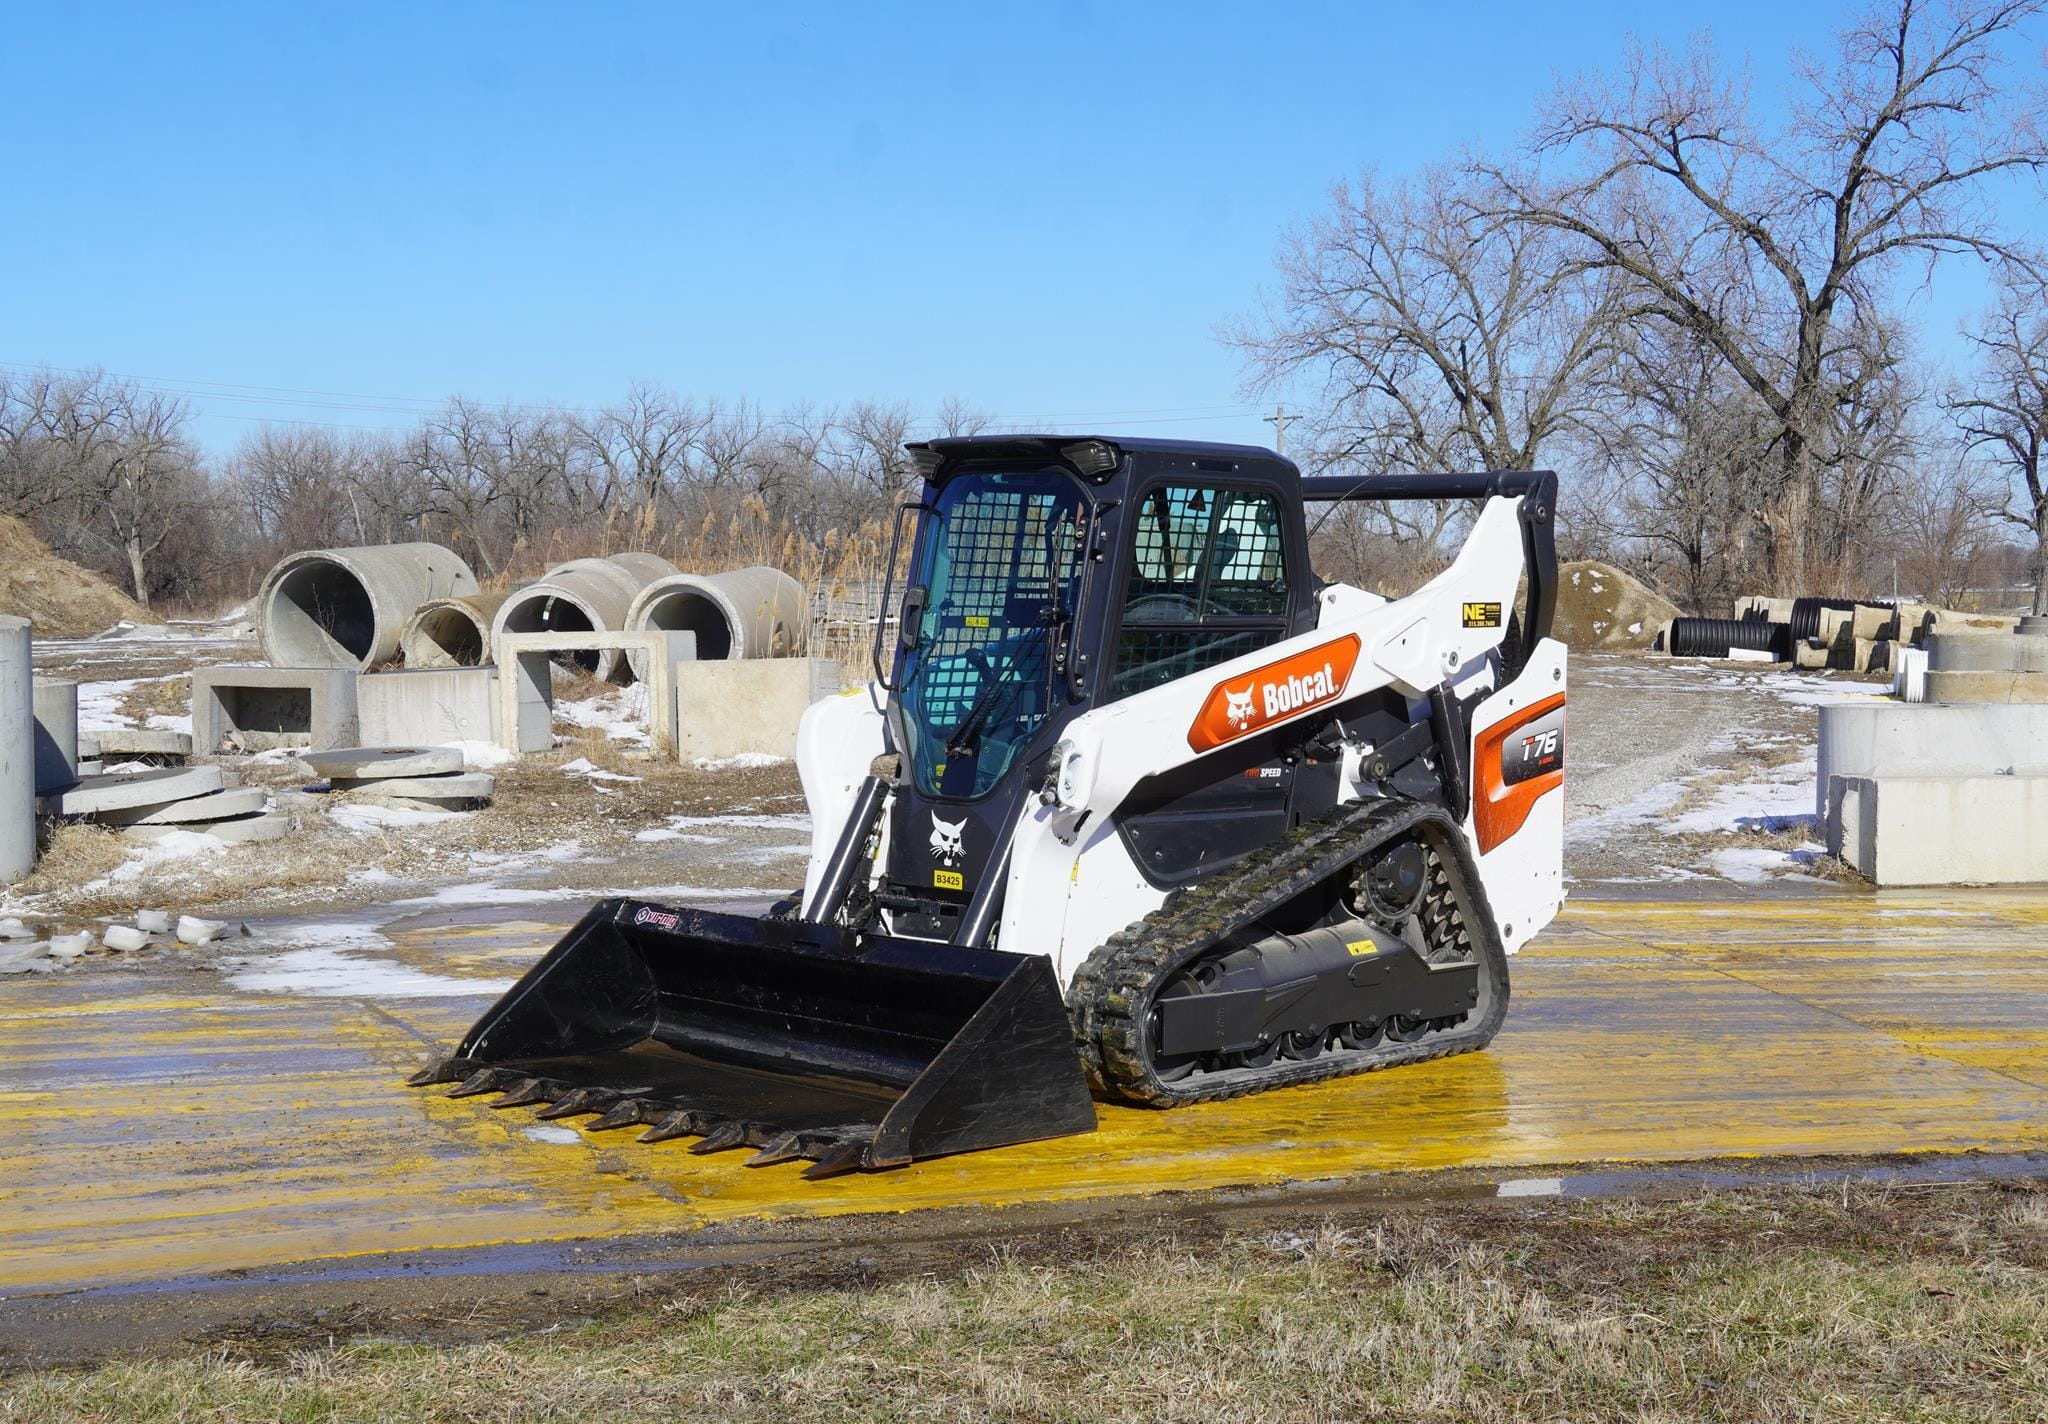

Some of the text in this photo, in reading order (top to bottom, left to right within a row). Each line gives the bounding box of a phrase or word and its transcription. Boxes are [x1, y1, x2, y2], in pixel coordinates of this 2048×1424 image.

[1464, 604, 1485, 620] NE
[1263, 662, 1335, 718] Bobcat
[1522, 729, 1558, 761] T76
[1260, 768, 1281, 778] SPEED
[936, 875, 960, 886] B3425
